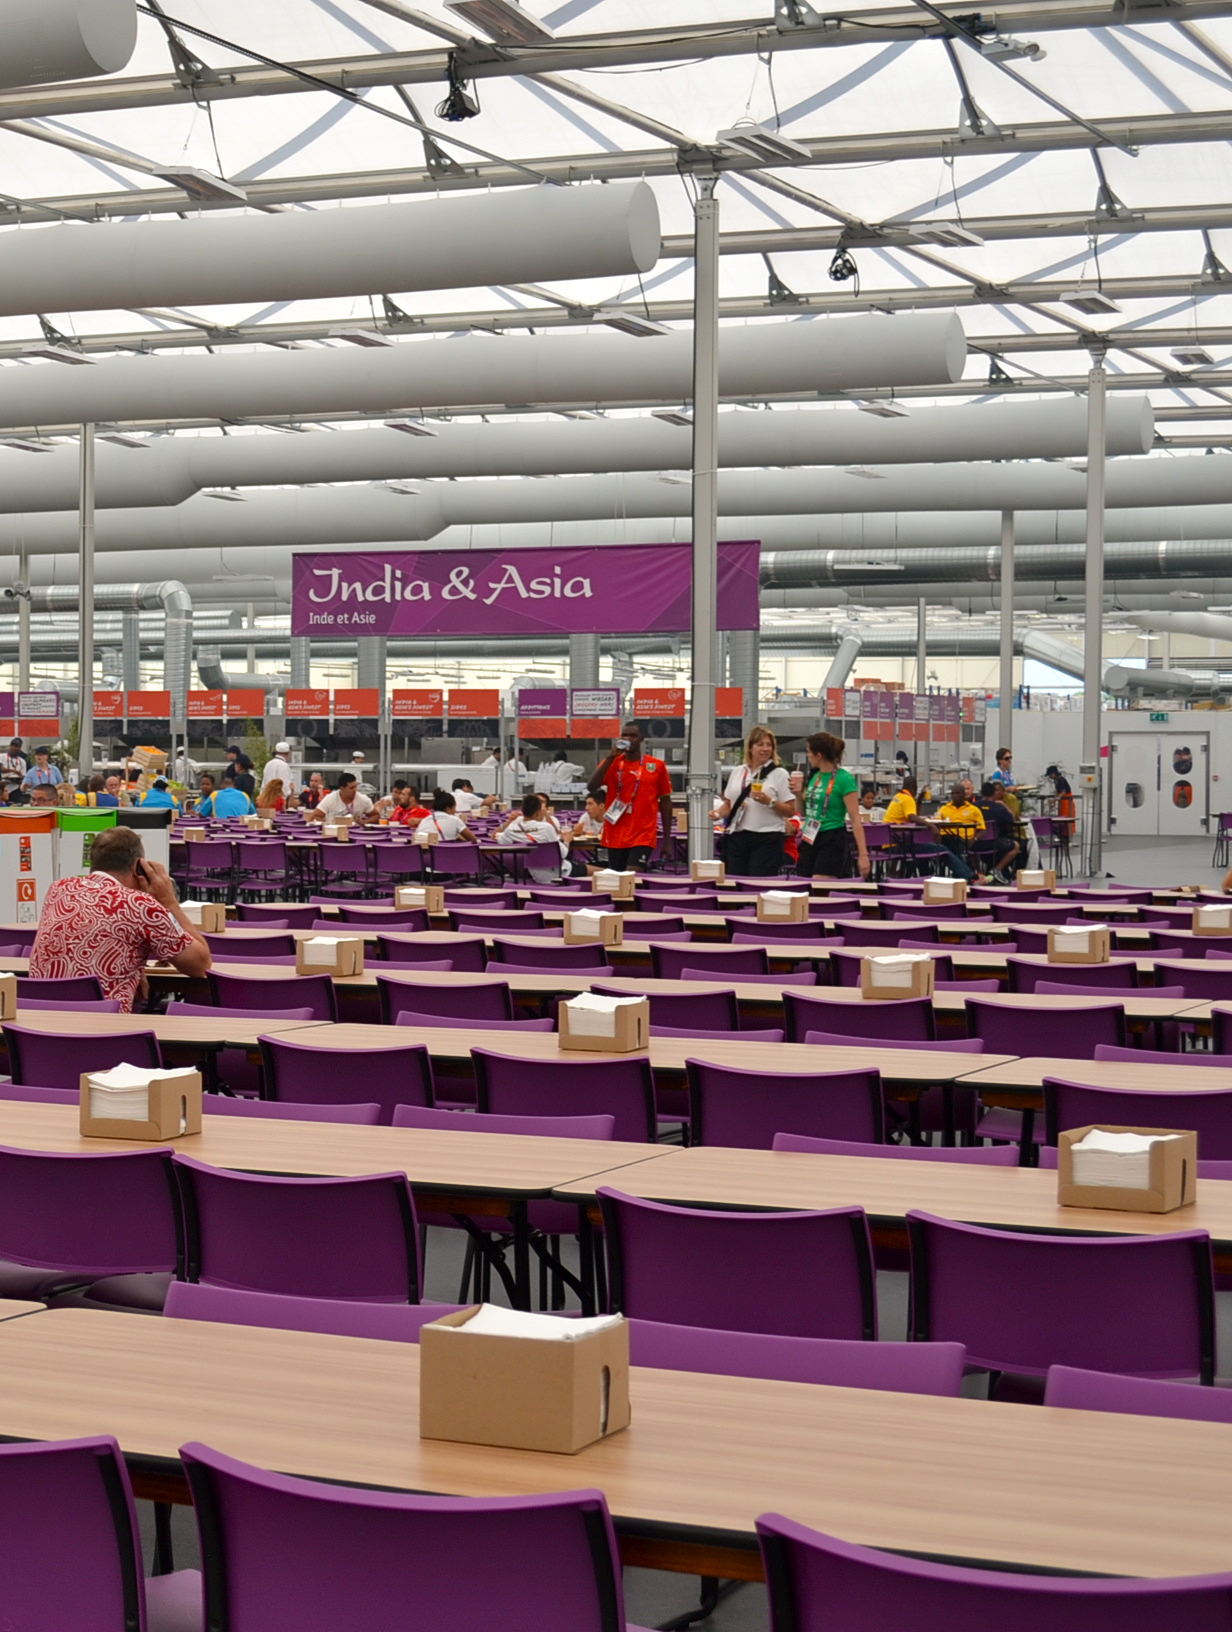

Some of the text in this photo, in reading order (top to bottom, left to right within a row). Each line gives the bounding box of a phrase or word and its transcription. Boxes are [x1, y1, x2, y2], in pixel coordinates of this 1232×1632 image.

[309, 564, 594, 605] India & Asia
[309, 611, 376, 625] Inde et Asie
